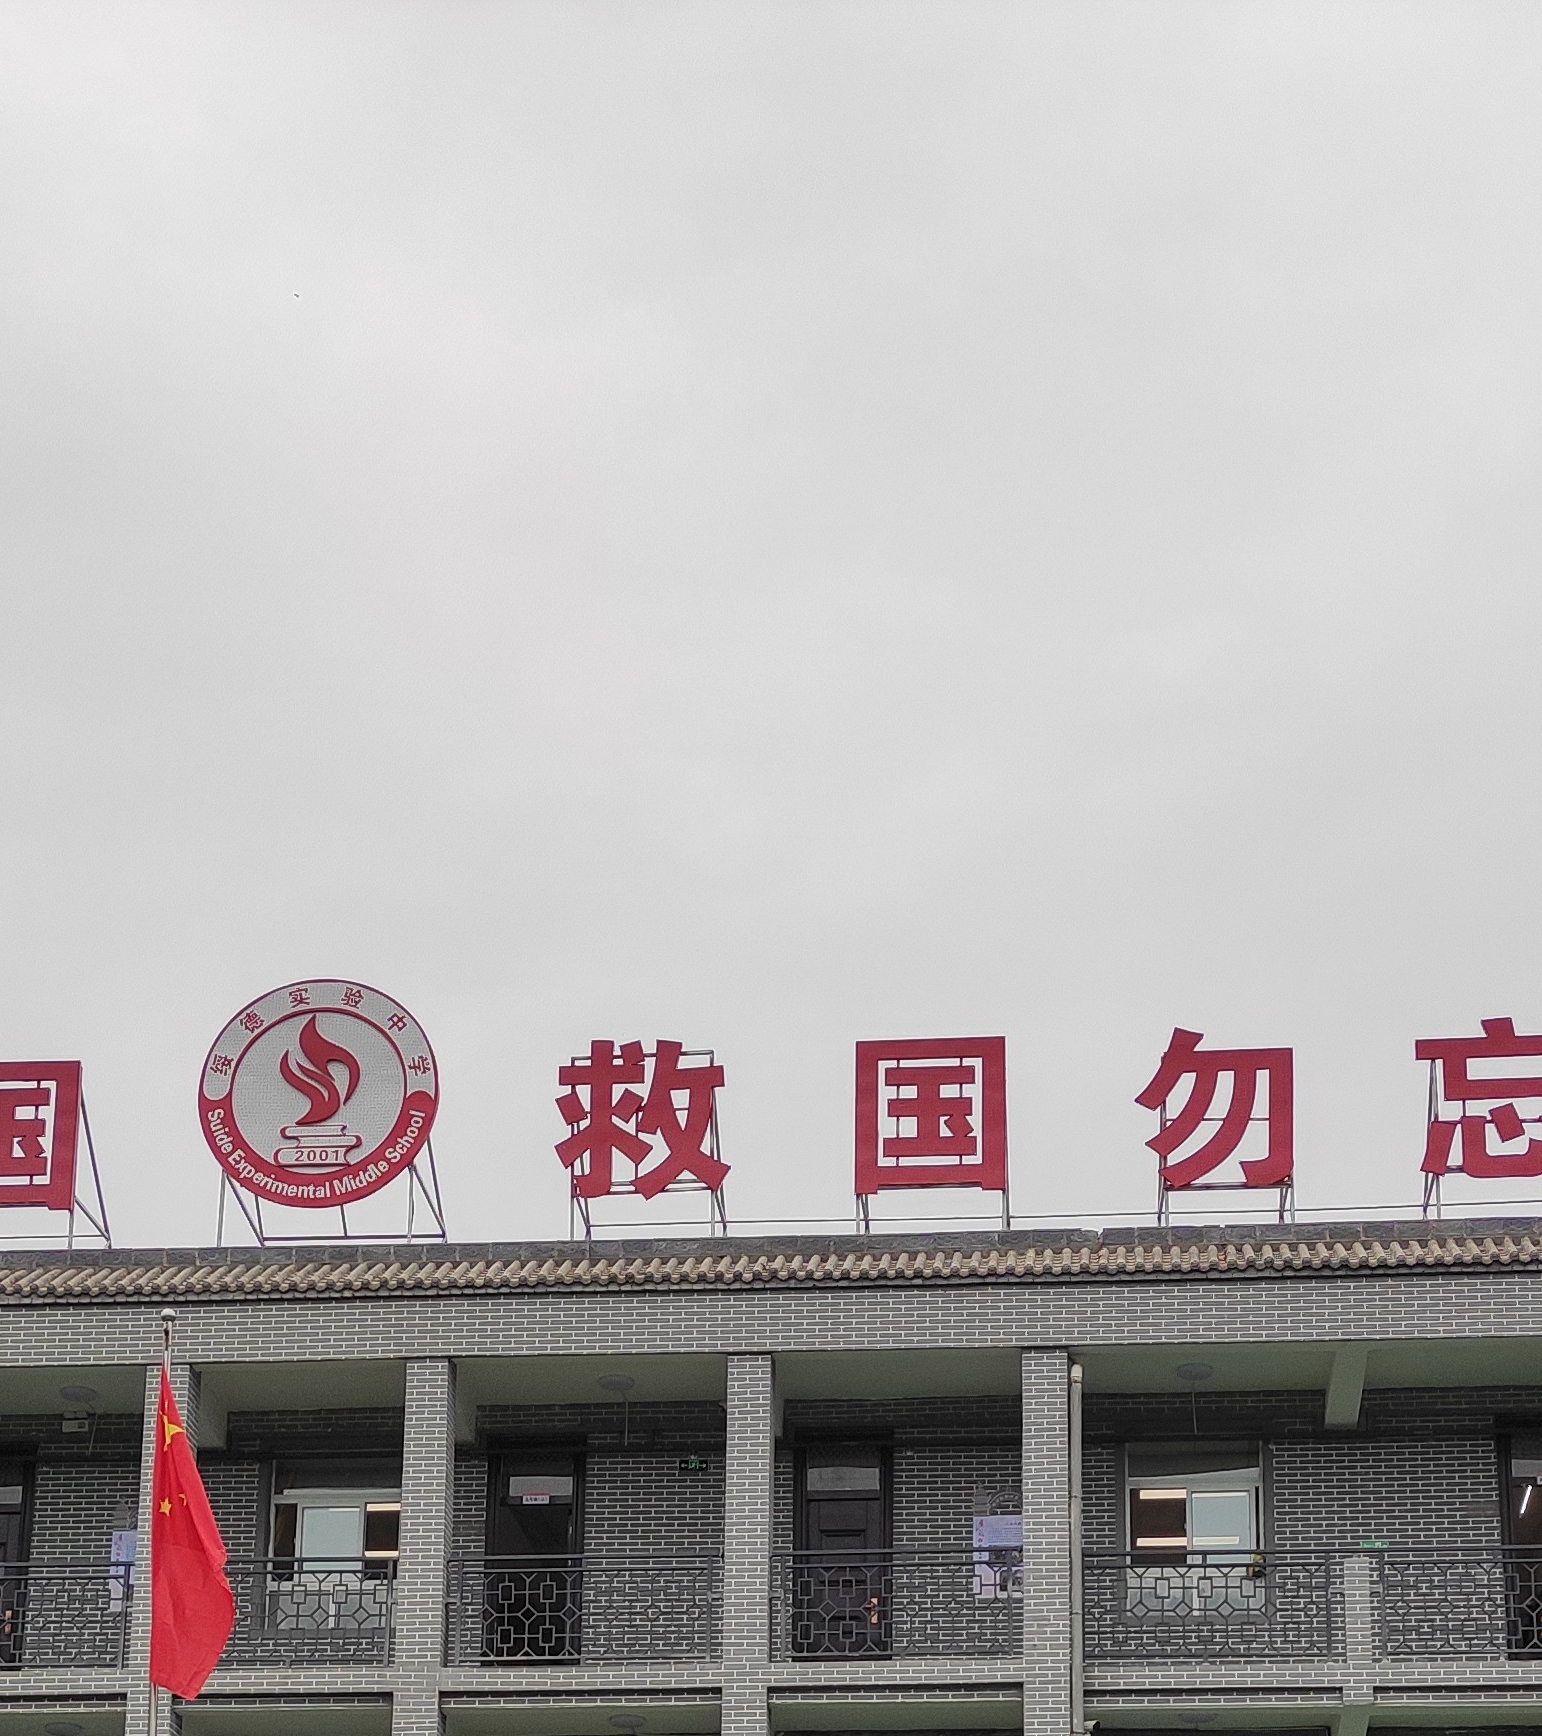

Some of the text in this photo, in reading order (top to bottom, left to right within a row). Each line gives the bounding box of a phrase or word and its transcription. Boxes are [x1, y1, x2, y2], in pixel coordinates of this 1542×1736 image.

[210, 986, 431, 1077] 绥德实验中学
[207, 1107, 427, 1200] Suide Experimental Middle School
[293, 1150, 340, 1162] 2001
